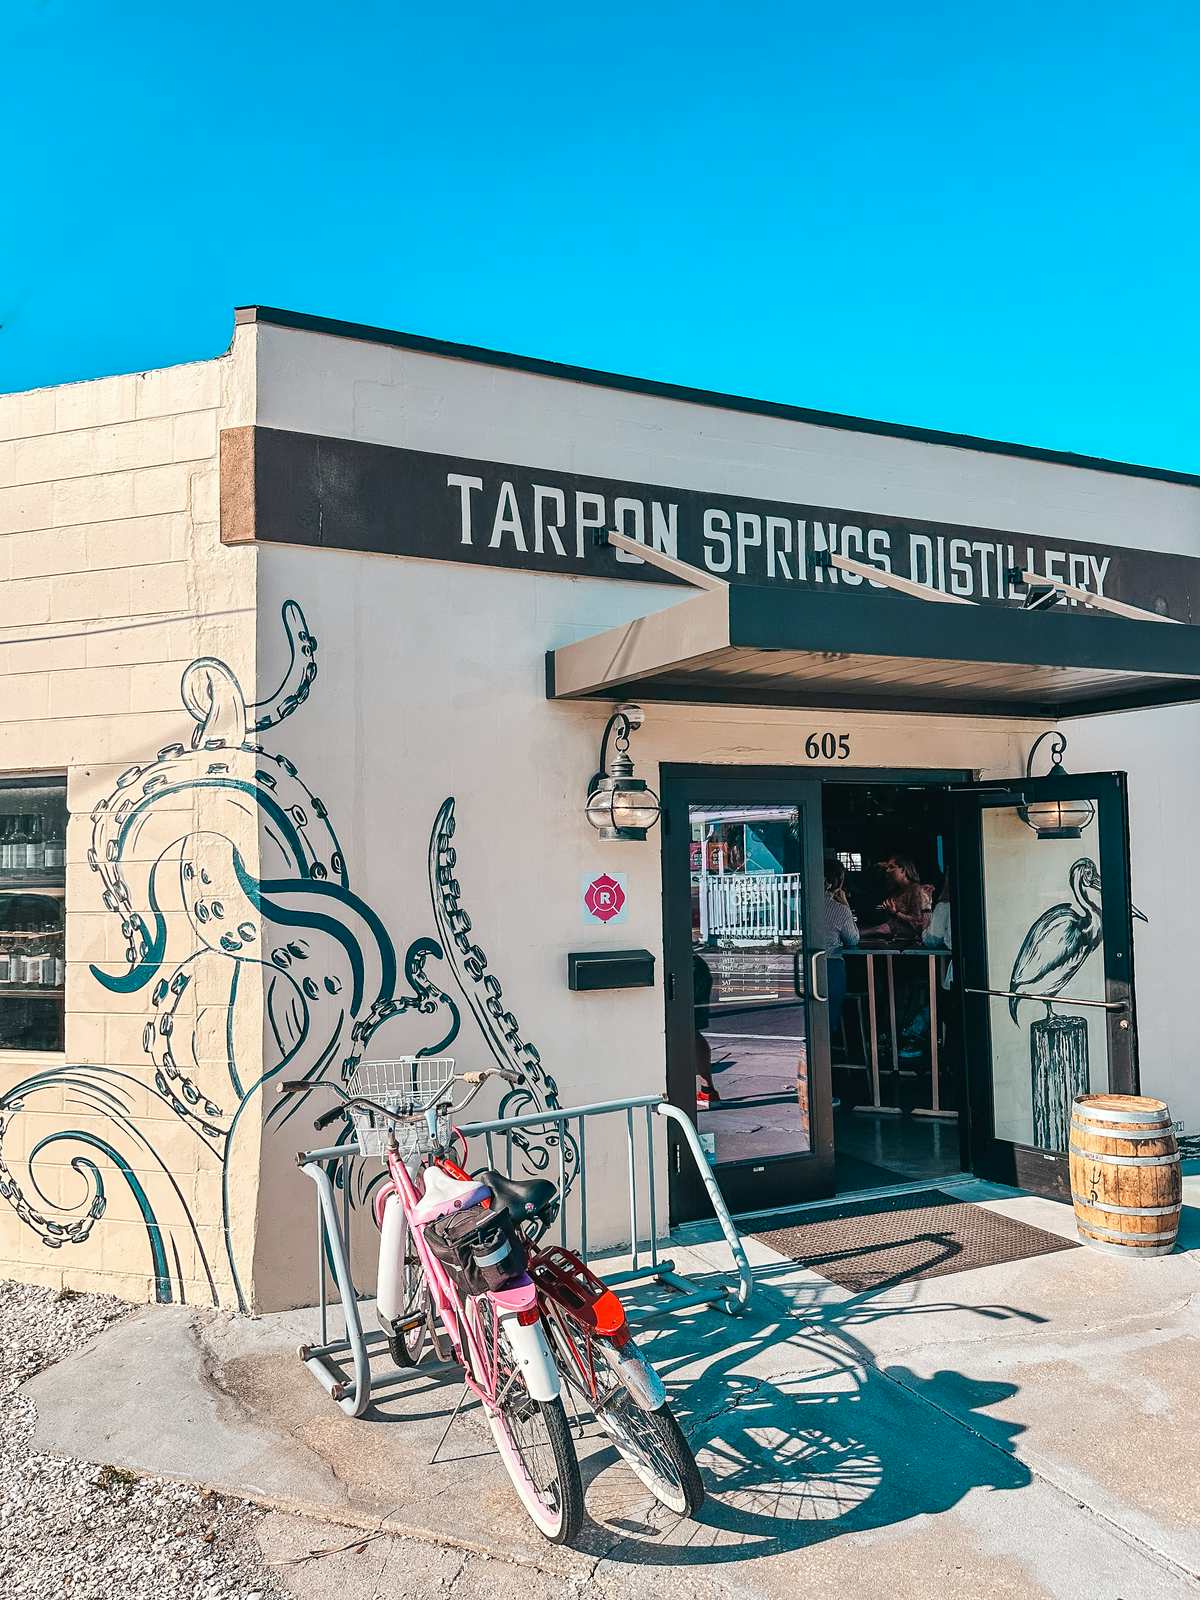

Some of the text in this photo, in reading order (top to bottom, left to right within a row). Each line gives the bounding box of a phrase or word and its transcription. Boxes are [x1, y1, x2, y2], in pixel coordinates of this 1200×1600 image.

[447, 473, 679, 564] TARPON
[703, 509, 892, 588] SPRINGS
[805, 732, 850, 759] 605
[600, 892, 611, 904] R
